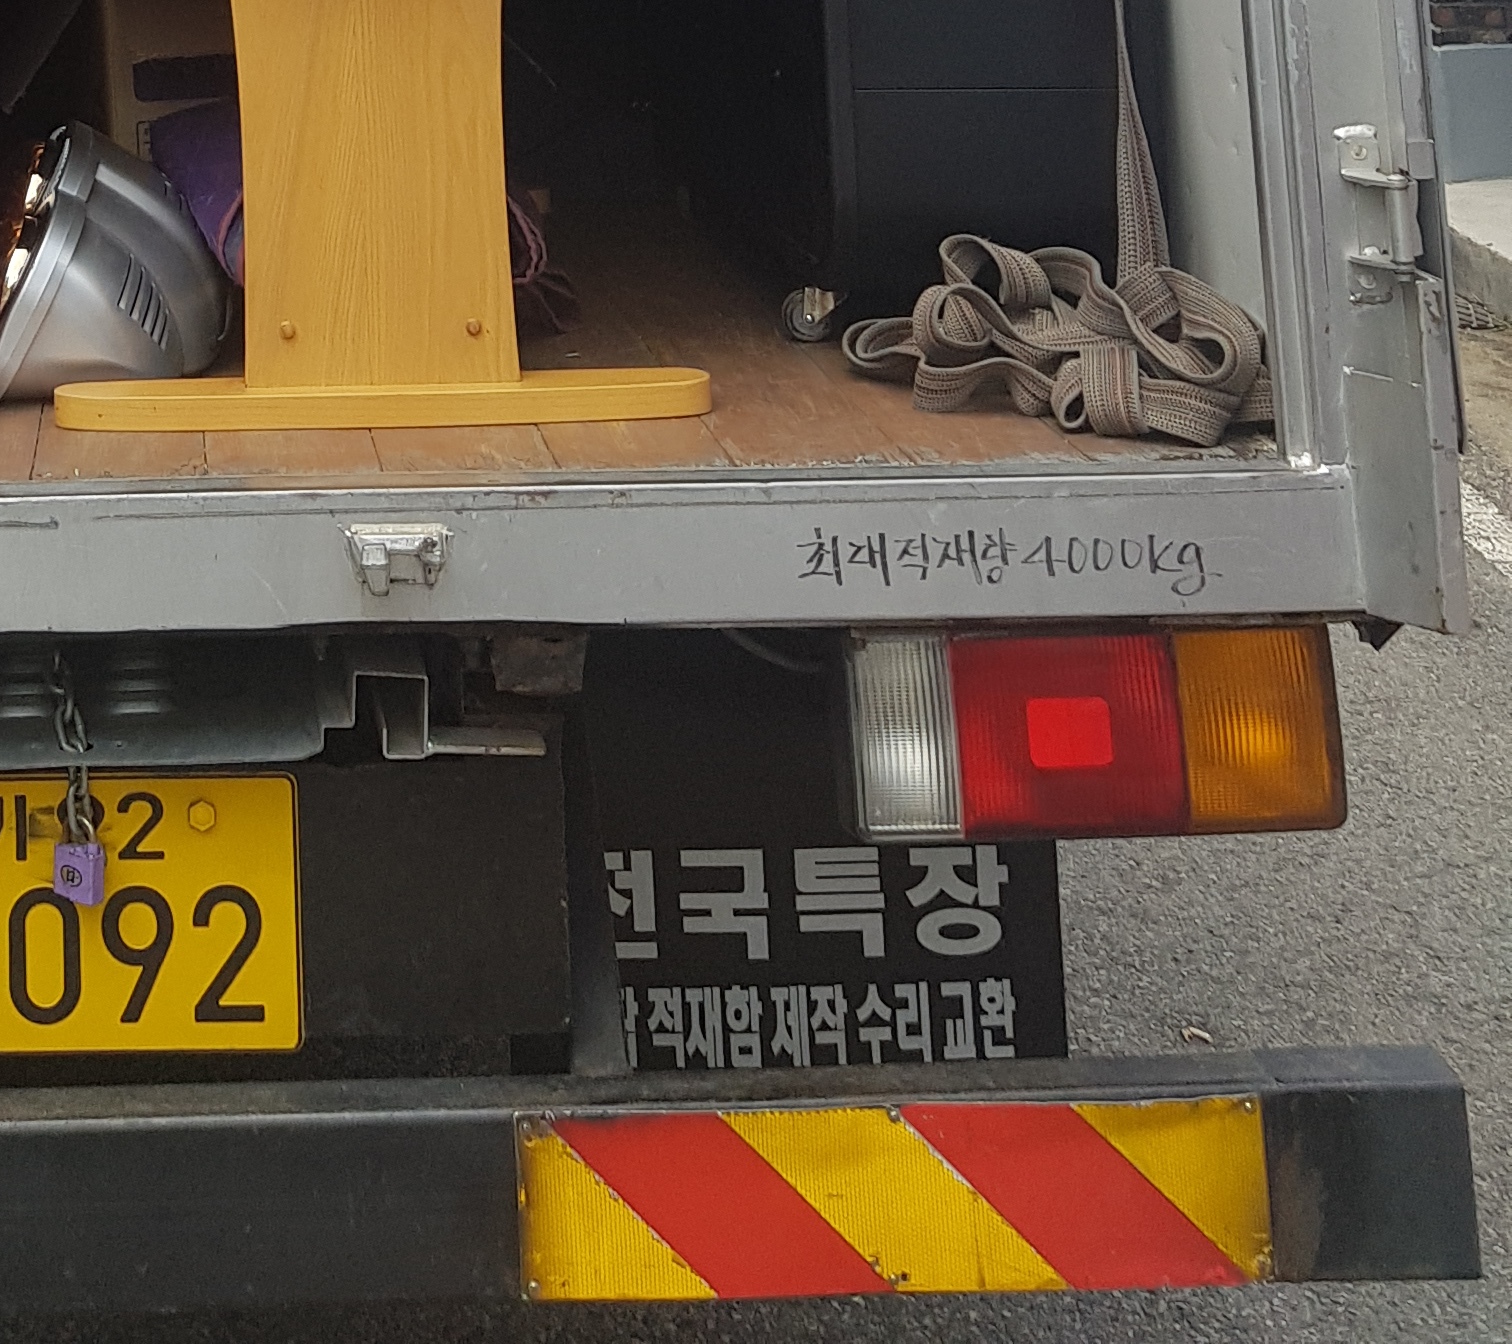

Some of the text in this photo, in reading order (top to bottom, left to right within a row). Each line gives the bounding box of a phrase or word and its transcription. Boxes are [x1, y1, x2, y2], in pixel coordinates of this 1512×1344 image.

[647, 983, 764, 1069] 적재함
[770, 983, 848, 1068] 제작
[855, 980, 934, 1064] 수리
[939, 977, 1017, 1061] 교환
